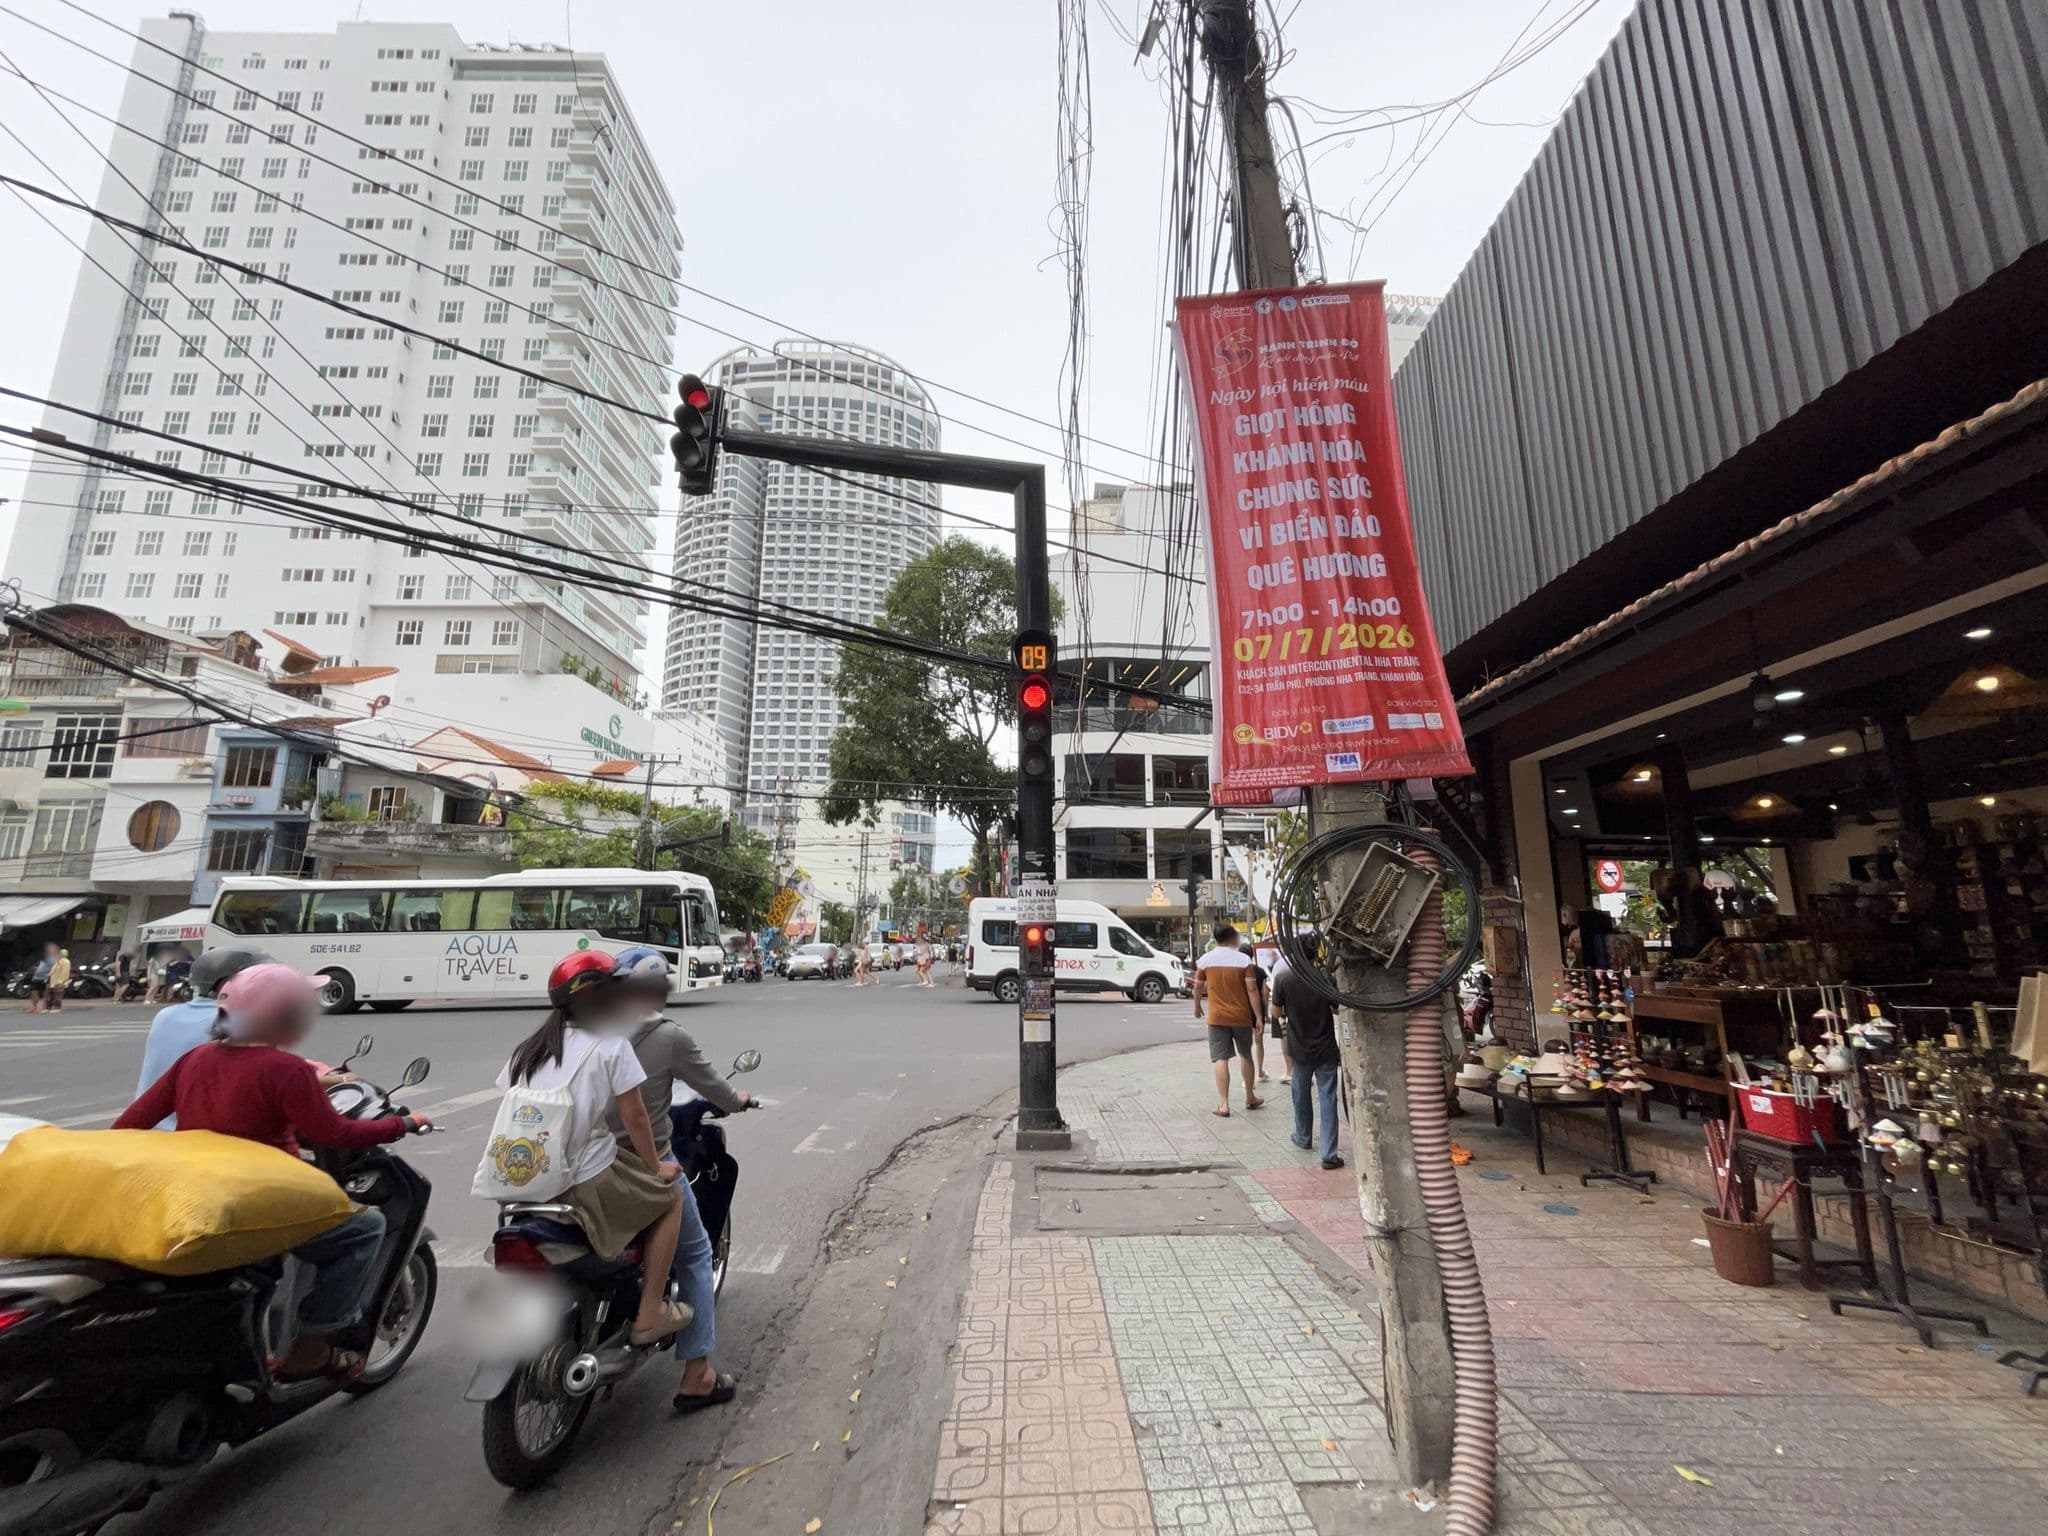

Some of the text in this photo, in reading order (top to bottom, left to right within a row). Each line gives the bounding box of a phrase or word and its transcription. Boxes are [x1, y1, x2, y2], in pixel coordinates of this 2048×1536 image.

[1210, 375, 1369, 406] Ngày hội hiến máu
[1234, 399, 1356, 438] GIỌT HỒNG
[1233, 433, 1368, 474] KHÁNH HÒA
[1238, 472, 1373, 512] CHUNG SỨC
[1239, 508, 1382, 550] VÌ BIỂN ĐẢO
[1247, 551, 1387, 592] QUÊ HƯƠNG
[1241, 602, 1304, 630] 7h00
[1327, 596, 1402, 618] 14h00
[1022, 645, 1046, 670] 09
[1288, 655, 1375, 675] INTERCONTINENTAL
[1374, 656, 1391, 667] NHA
[1392, 655, 1421, 668] TRANG
[1336, 673, 1353, 685] NHA
[580, 726, 603, 749] GREEN
[603, 738, 626, 759] WORLD
[1237, 730, 1252, 739] CP
[1263, 724, 1299, 740] BIDV
[446, 935, 518, 956] AQUA
[445, 957, 517, 976] TRAVEL
[1054, 958, 1085, 970] anex
